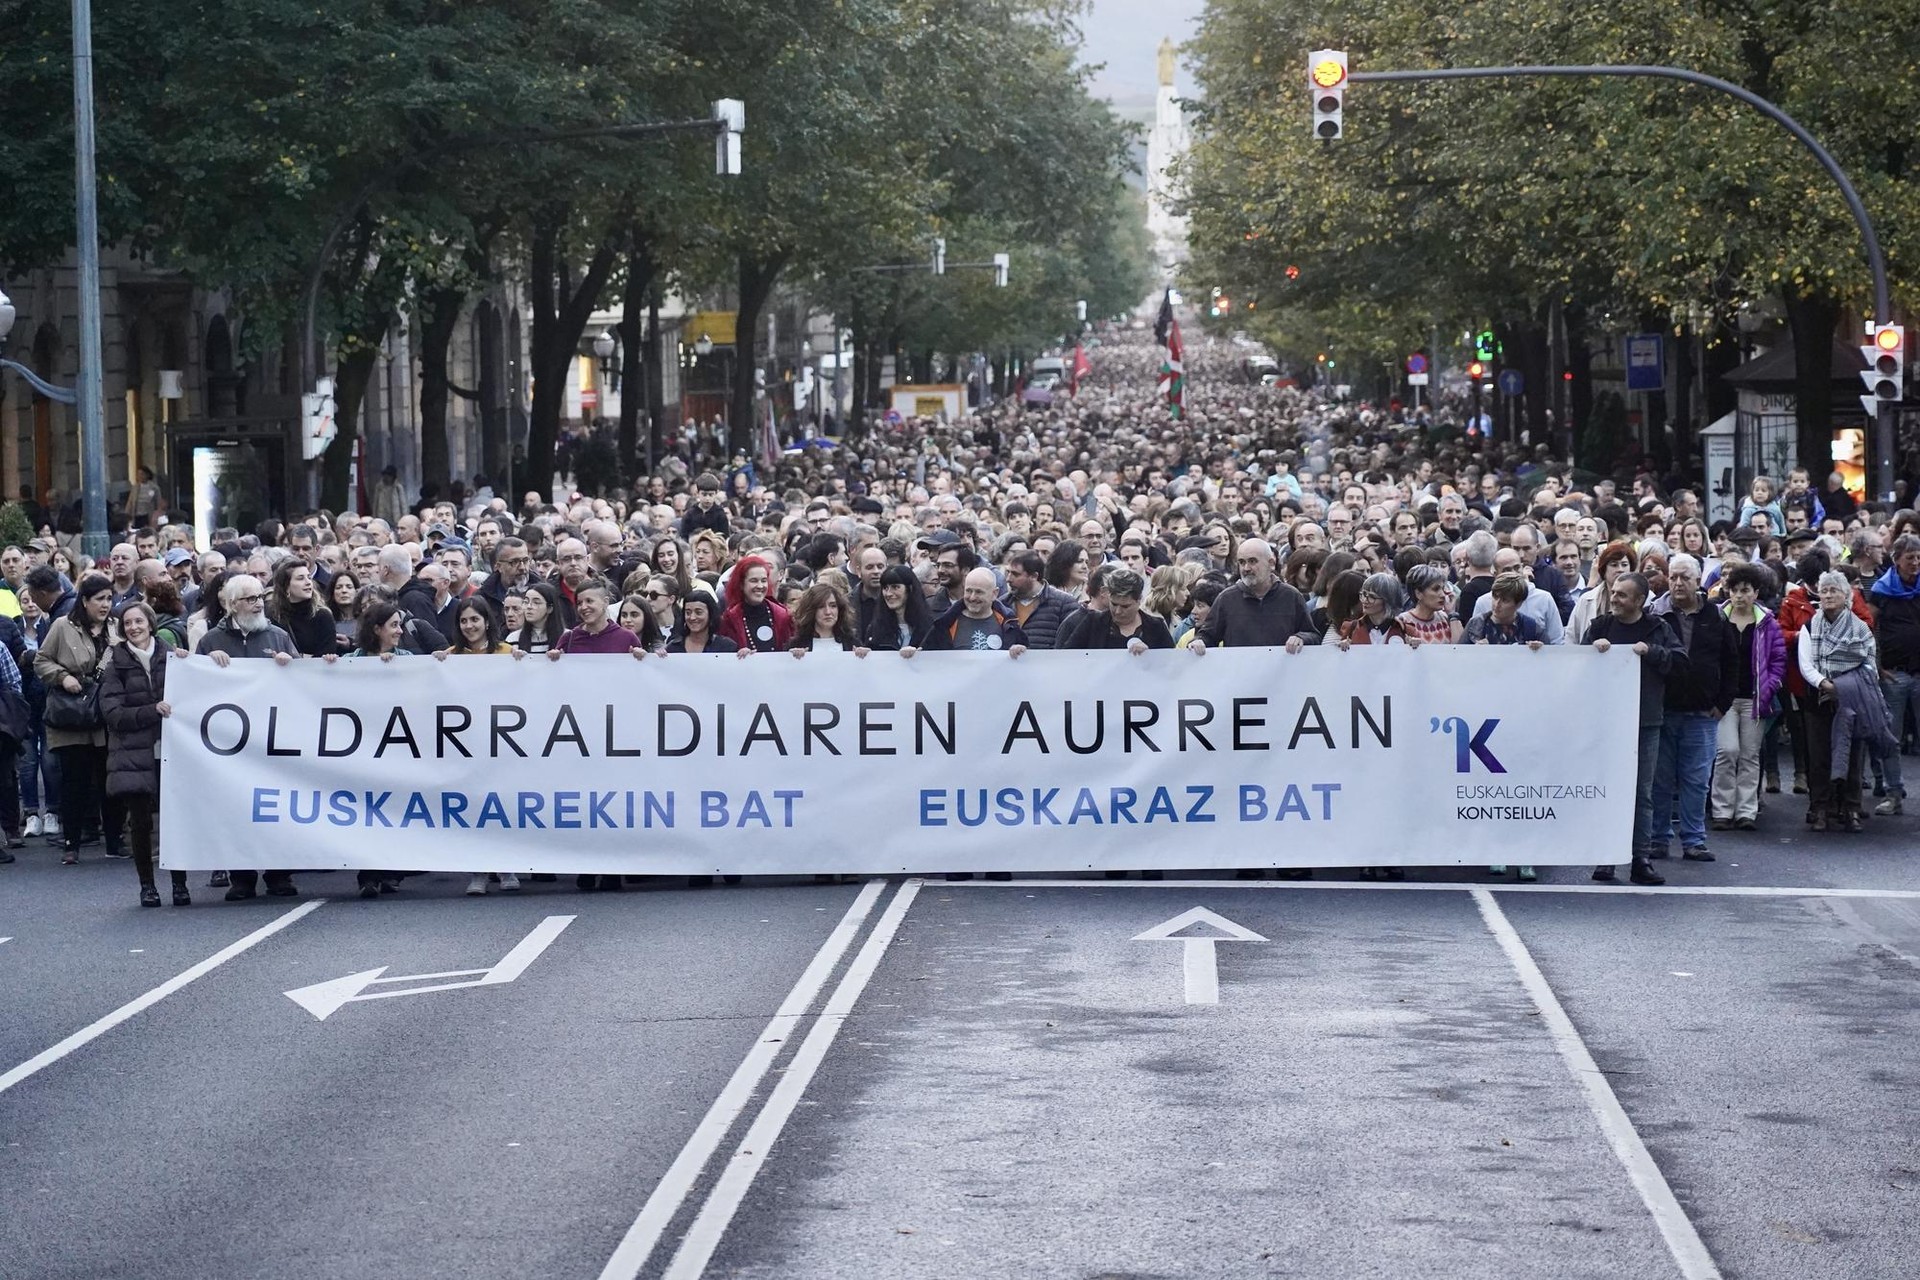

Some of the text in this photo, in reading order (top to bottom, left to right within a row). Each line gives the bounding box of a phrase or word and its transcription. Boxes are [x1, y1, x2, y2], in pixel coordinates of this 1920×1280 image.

[200, 695, 1393, 758] OLDARRALDIAREN AURREAN
[252, 787, 804, 830] EUSKARAREKIN BAT
[919, 782, 1342, 827] EUSKARAZ BAT
[1456, 784, 1606, 800] EUSKALGINTZAREN
[1456, 806, 1557, 821] KONTSEILUA
